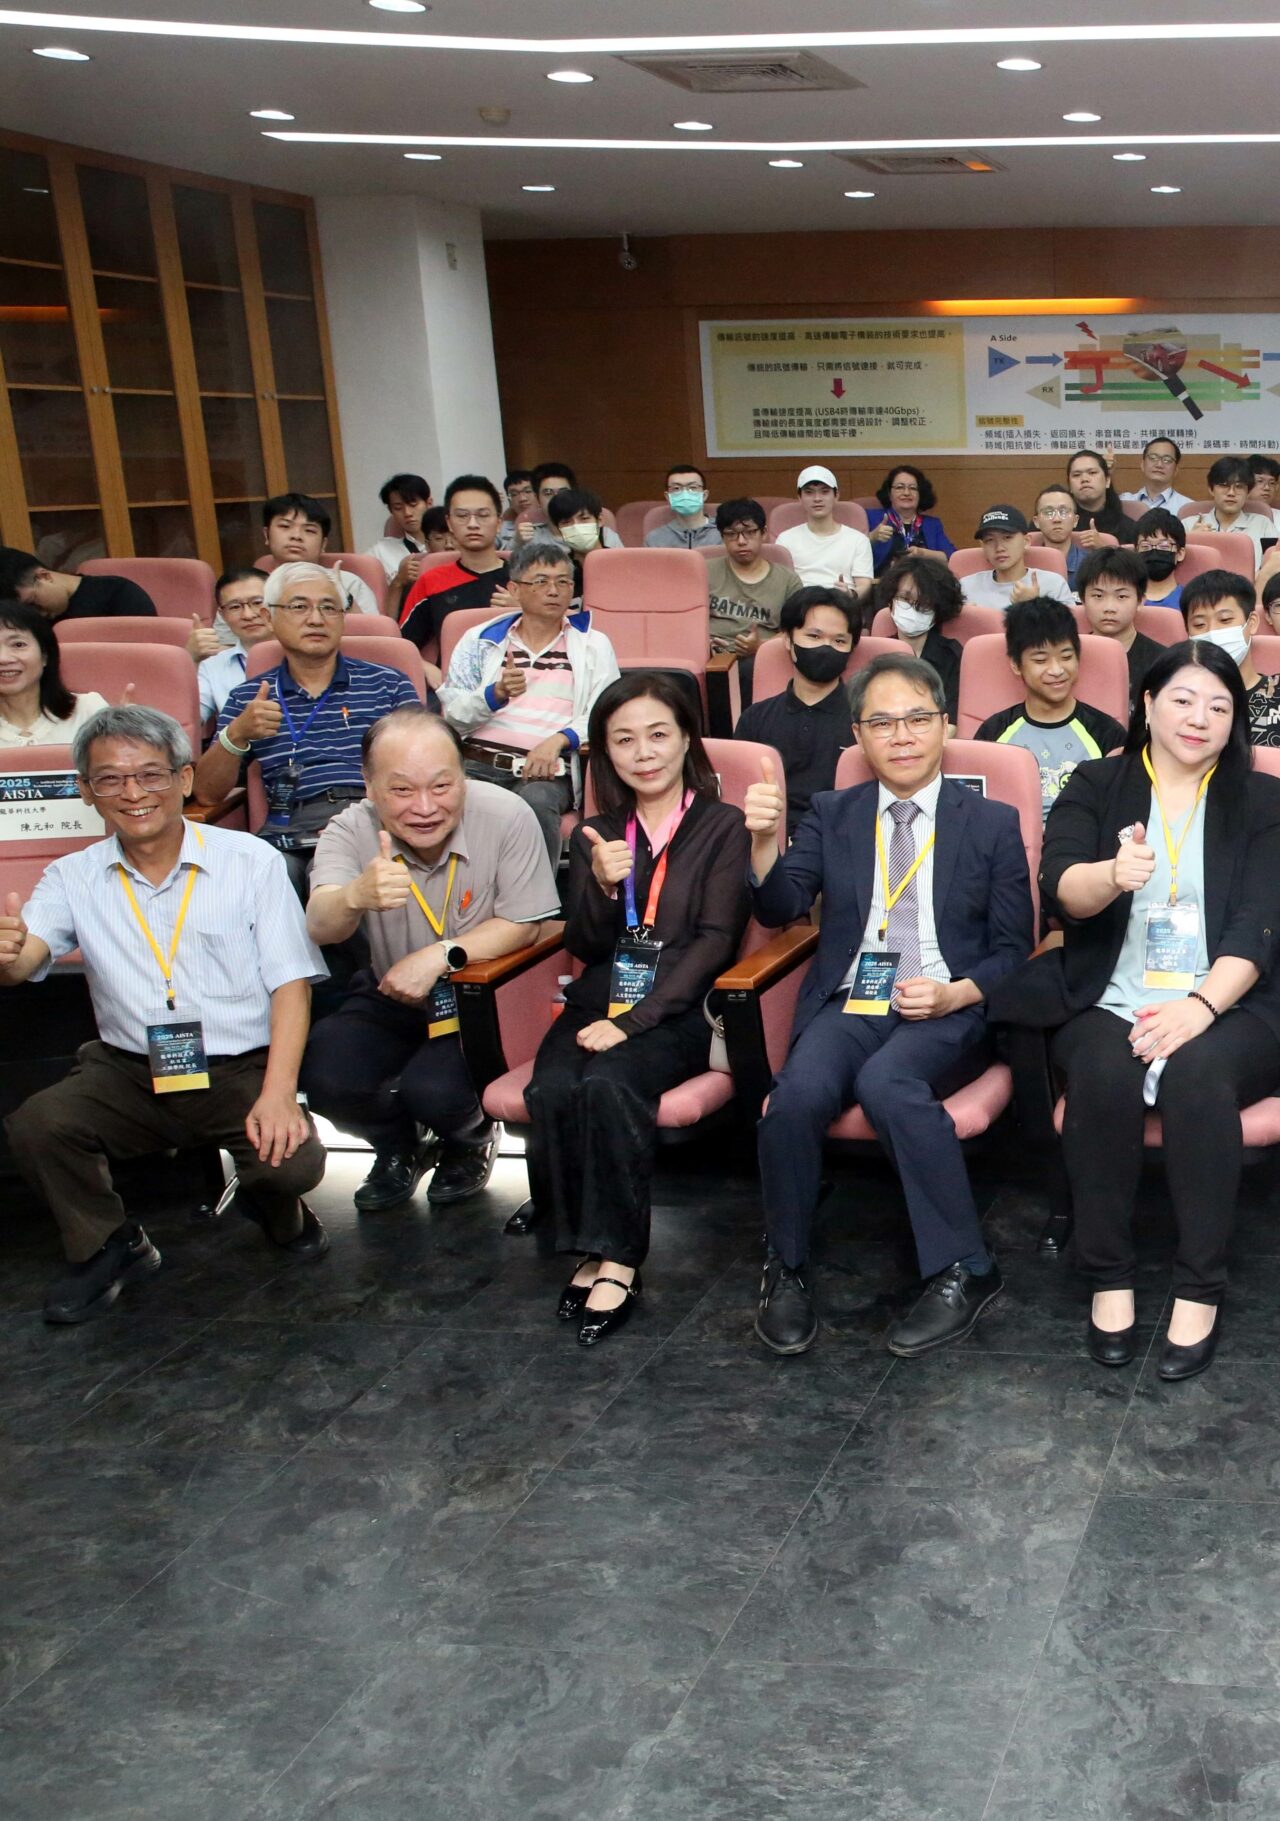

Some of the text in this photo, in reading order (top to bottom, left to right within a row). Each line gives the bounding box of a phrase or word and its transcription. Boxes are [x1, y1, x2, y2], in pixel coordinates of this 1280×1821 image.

[999, 334, 1018, 342] Side
[709, 594, 771, 621] BATMAN
[0, 778, 31, 788] 2025
[2, 789, 44, 800] AISTA
